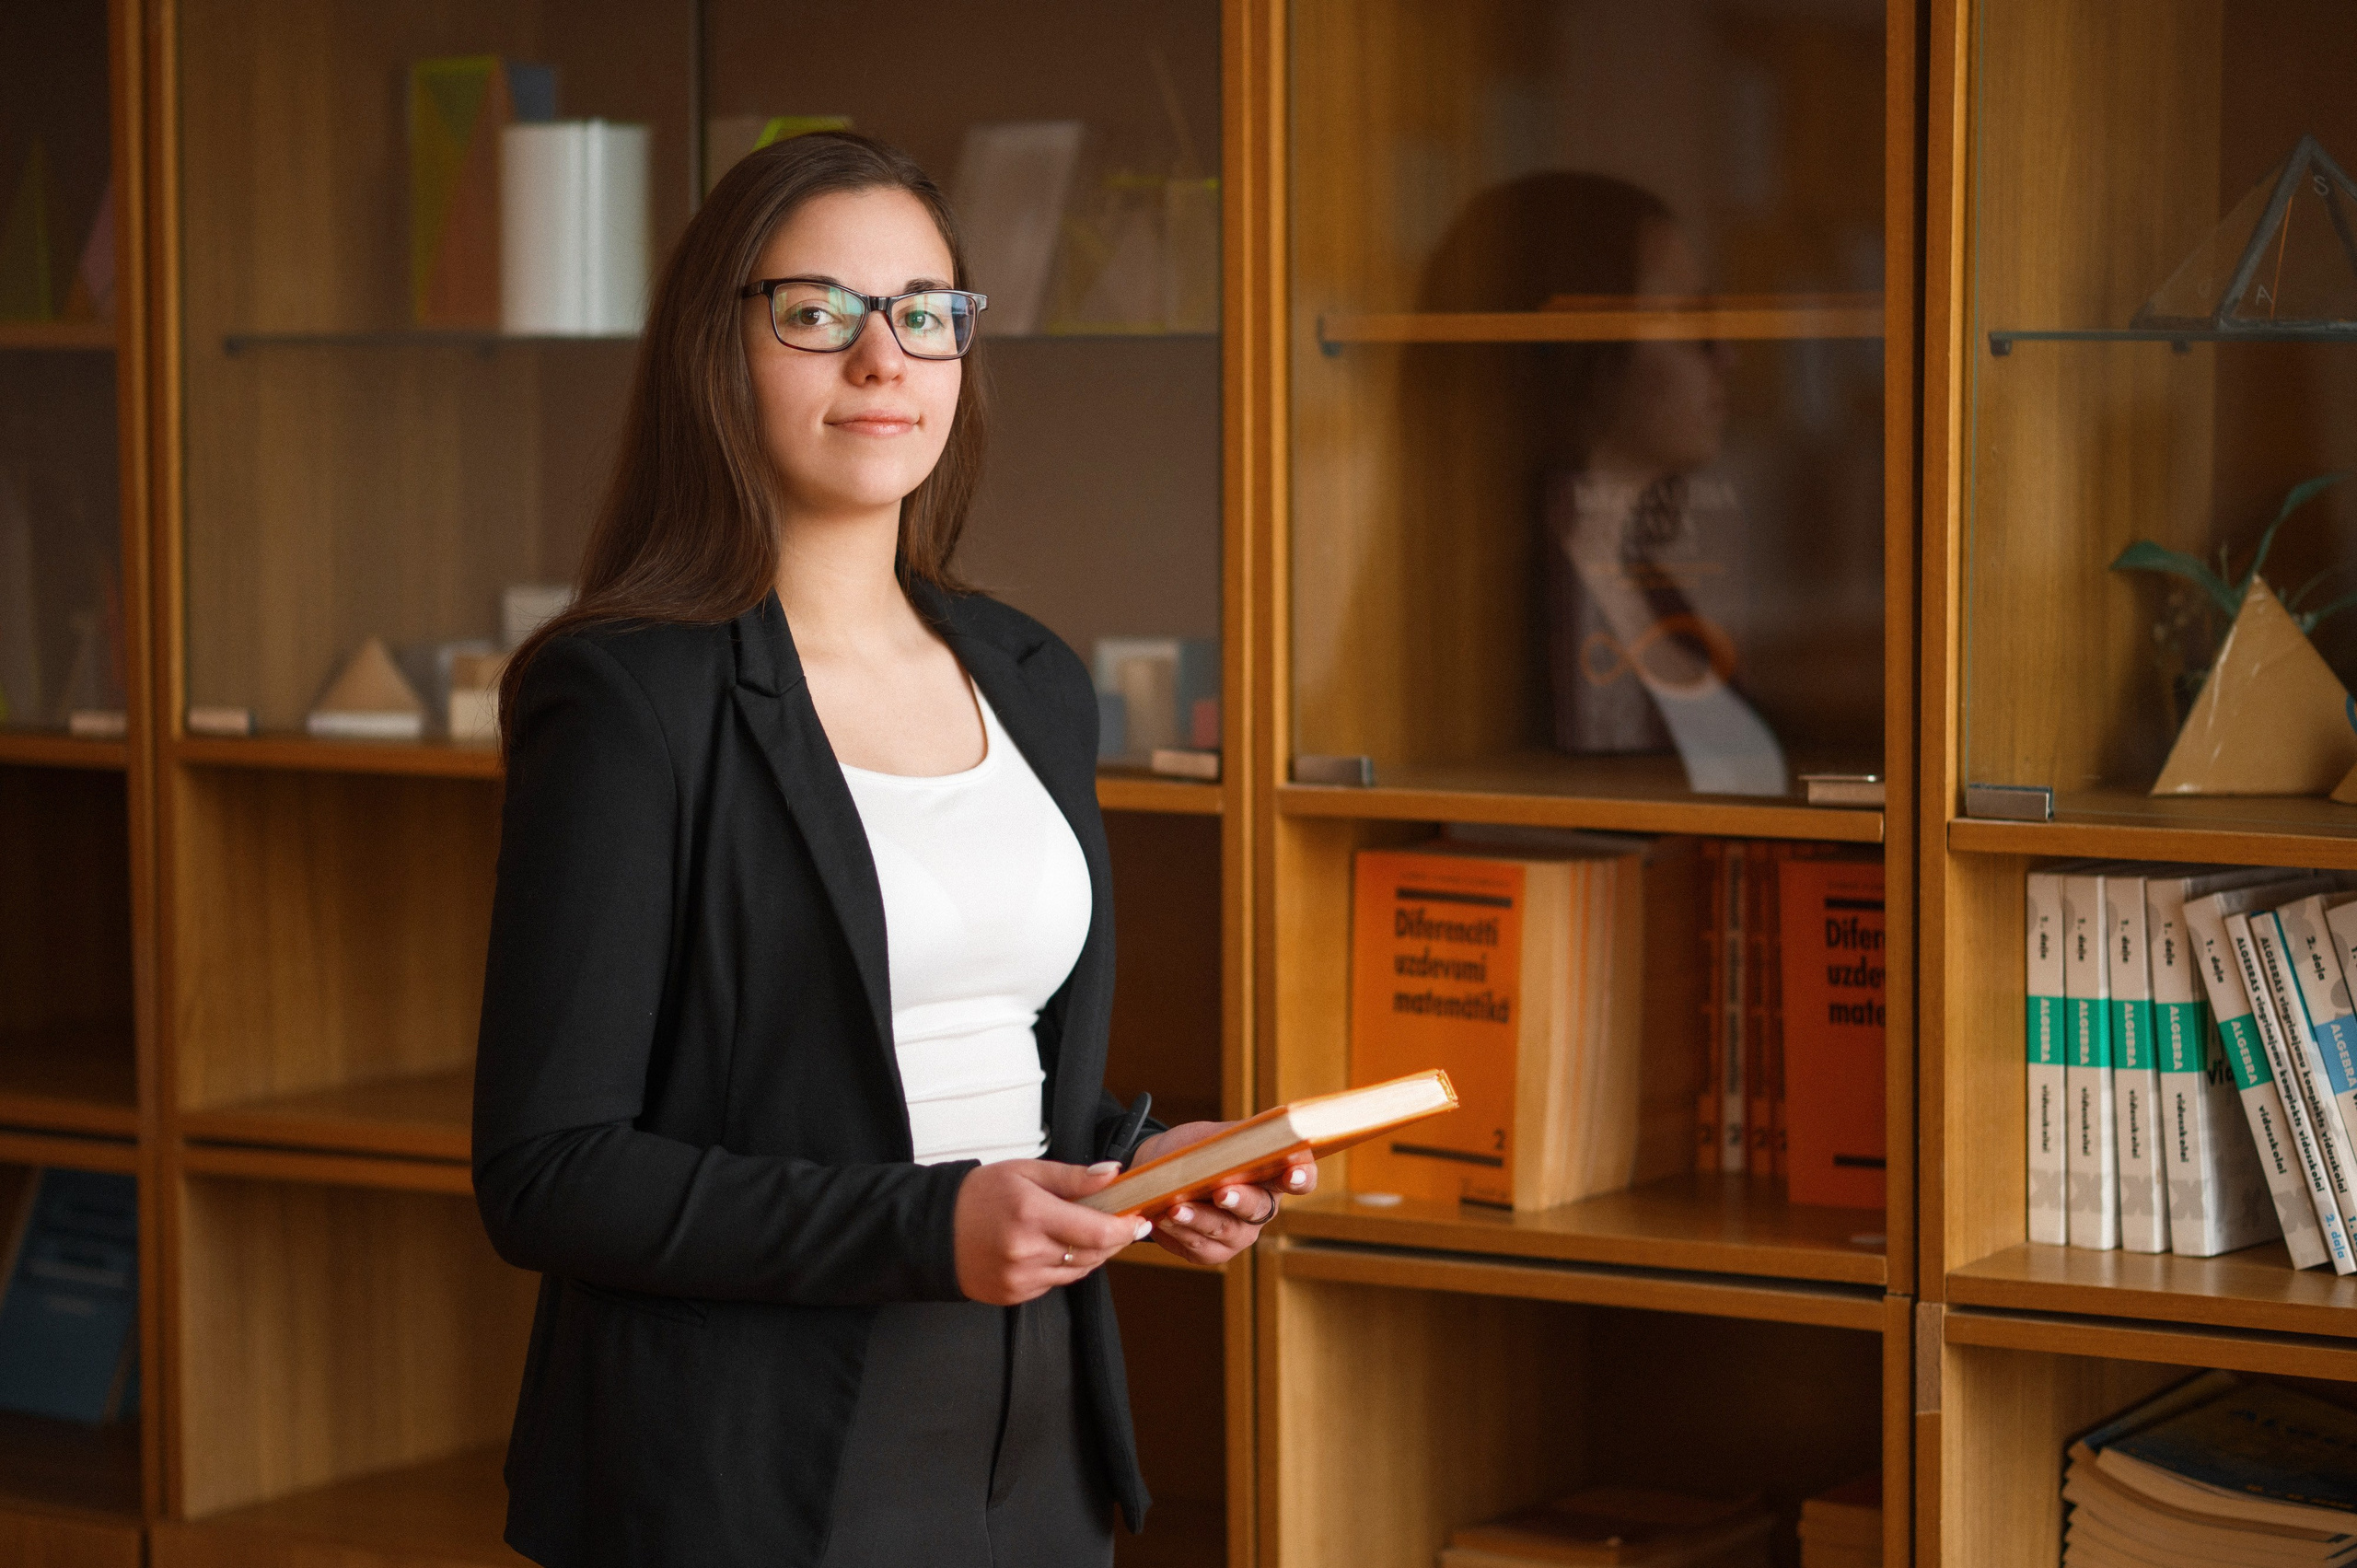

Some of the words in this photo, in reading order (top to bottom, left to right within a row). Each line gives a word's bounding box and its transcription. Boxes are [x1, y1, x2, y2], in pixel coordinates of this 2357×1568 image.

[1828, 955, 1886, 988] uzde
[2124, 1002, 2136, 1068] ALGEBRA
[2169, 1005, 2184, 1071] ALGEBRA
[2230, 1020, 2258, 1086] ALGEBRA
[2235, 936, 2260, 993] ALGEBRAS
[2299, 1130, 2326, 1192] vidusskolai
[2259, 936, 2284, 994] ALGEBRAS
[2322, 1131, 2348, 1194] vidusskolai
[2329, 1023, 2357, 1088] ALGEBRA
[1493, 1128, 1506, 1151] 2
[2258, 1105, 2288, 1175] vidusskolai
[2325, 1213, 2336, 1227] 2.
